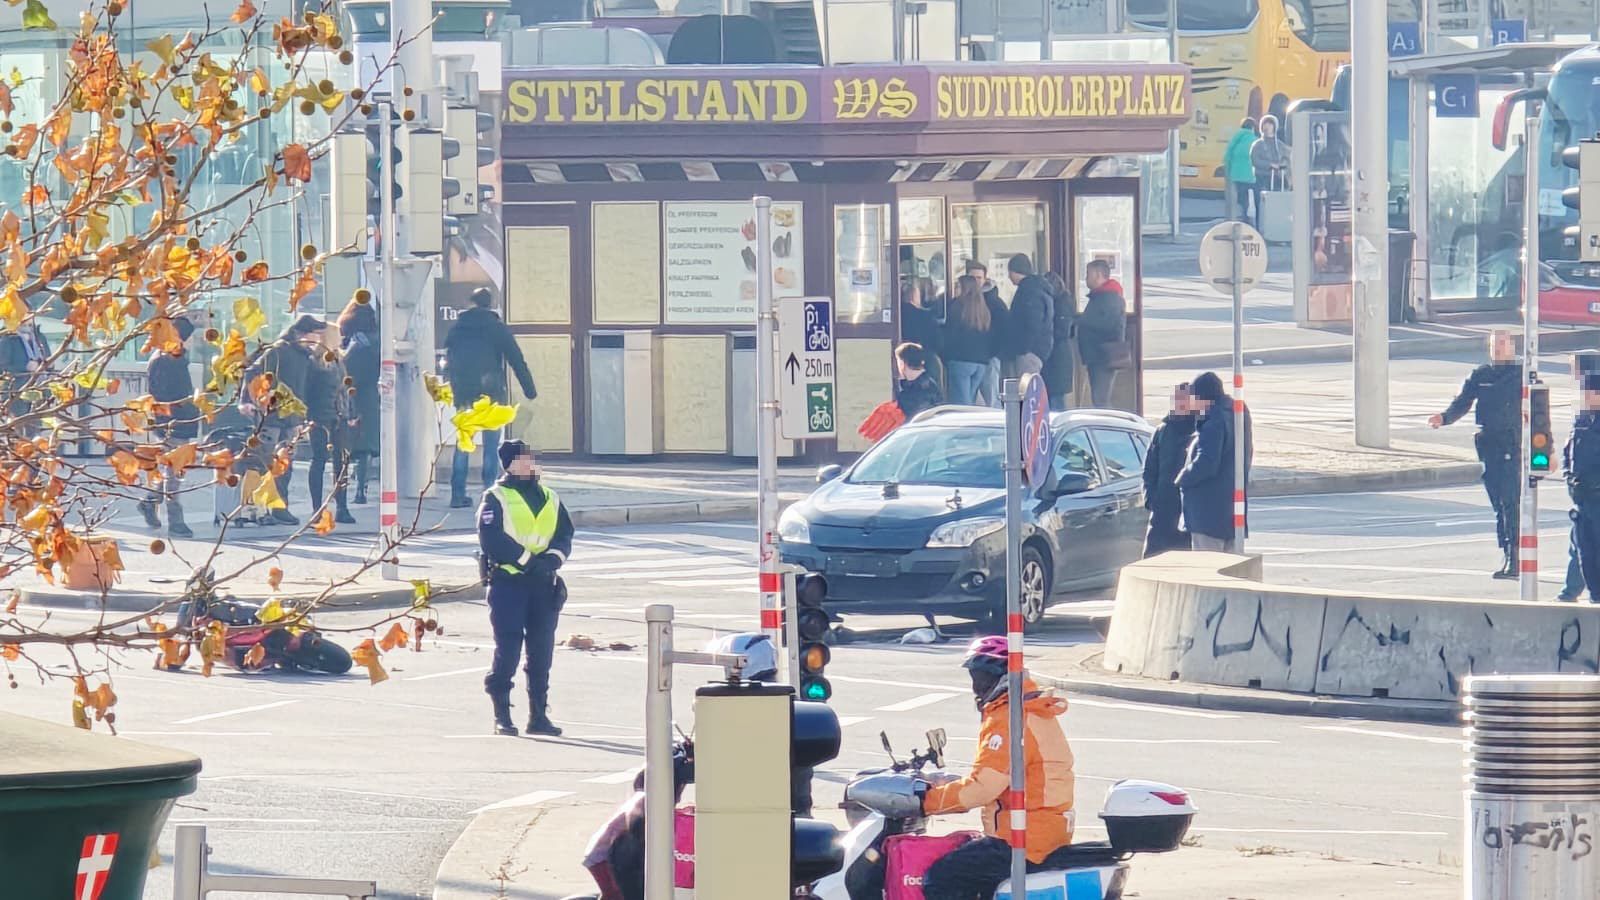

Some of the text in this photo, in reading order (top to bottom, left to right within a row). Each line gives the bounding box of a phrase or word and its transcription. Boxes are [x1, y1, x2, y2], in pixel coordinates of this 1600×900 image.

[502, 78, 808, 123] STELSTAND
[440, 306, 459, 320] Ta
[805, 358, 832, 377] 250 m
